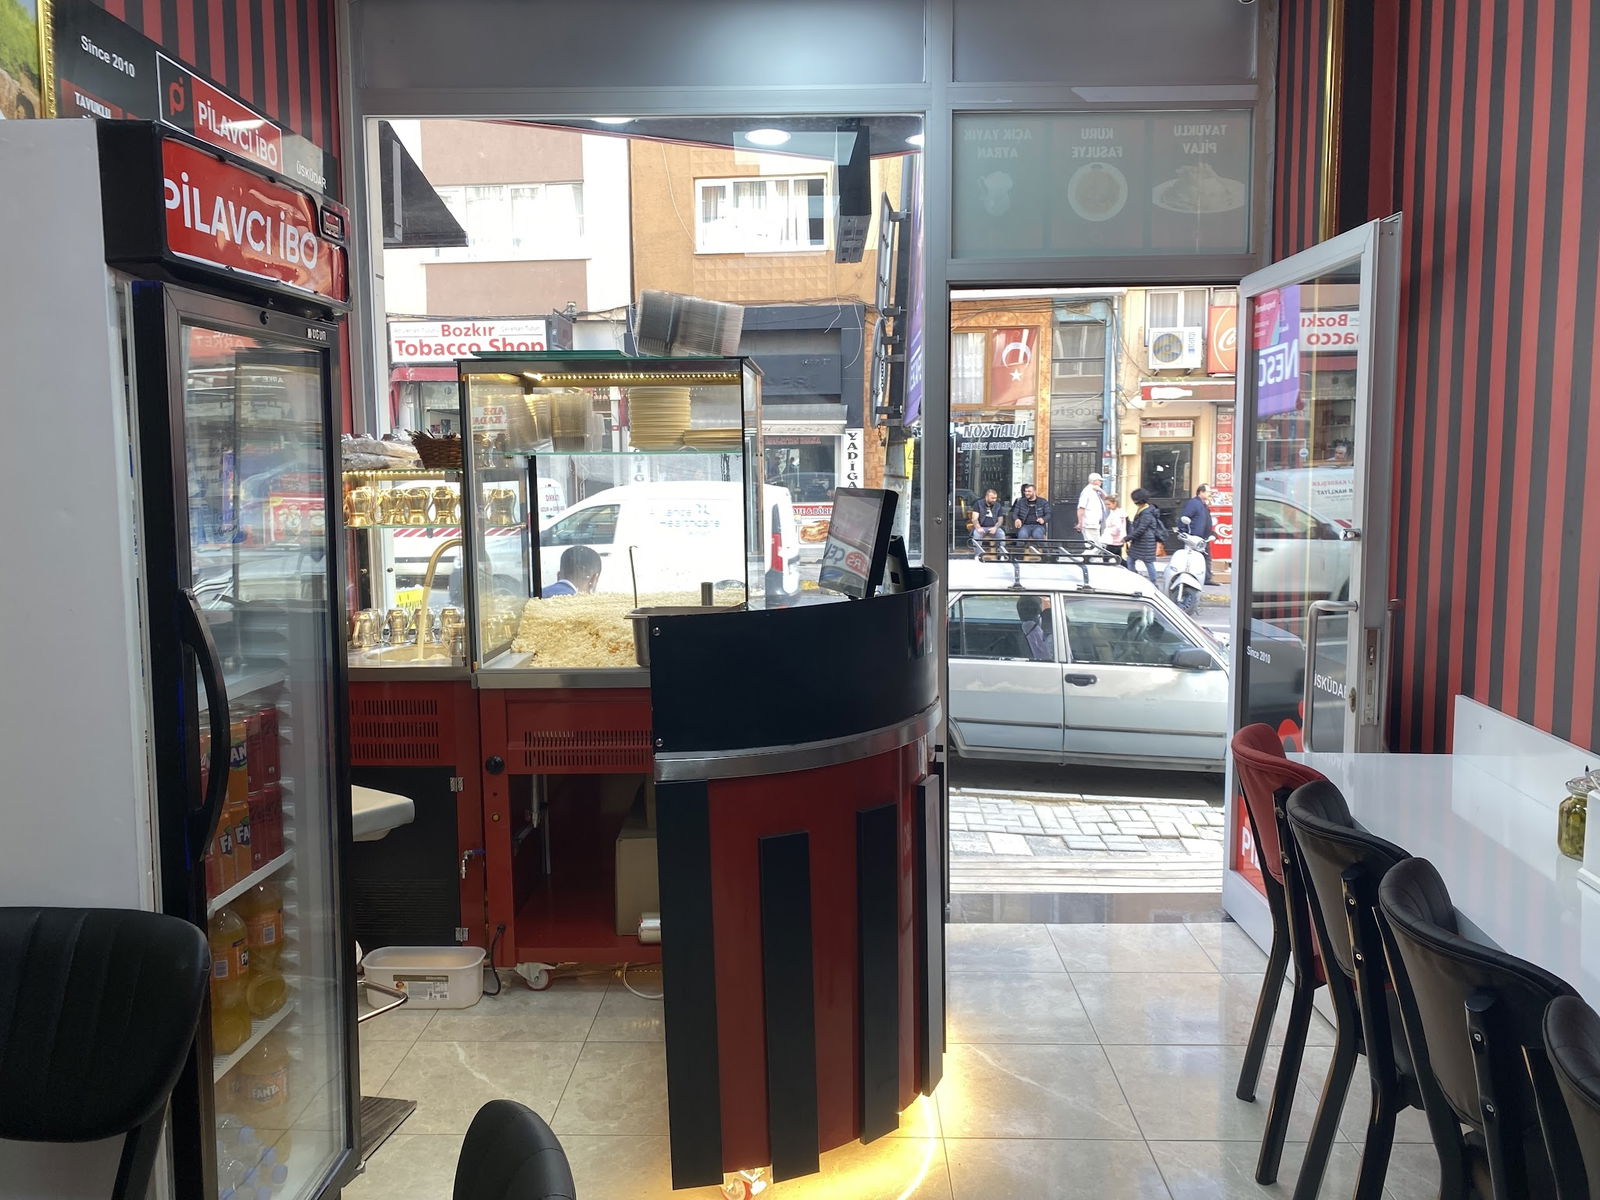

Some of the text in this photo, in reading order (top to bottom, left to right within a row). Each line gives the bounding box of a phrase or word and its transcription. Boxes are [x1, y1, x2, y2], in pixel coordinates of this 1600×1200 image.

[80, 35, 136, 78] Since 2010
[441, 322, 496, 337] Bozkır
[395, 336, 544, 356] Tobacco Shop
[1246, 645, 1271, 665] Since 2010
